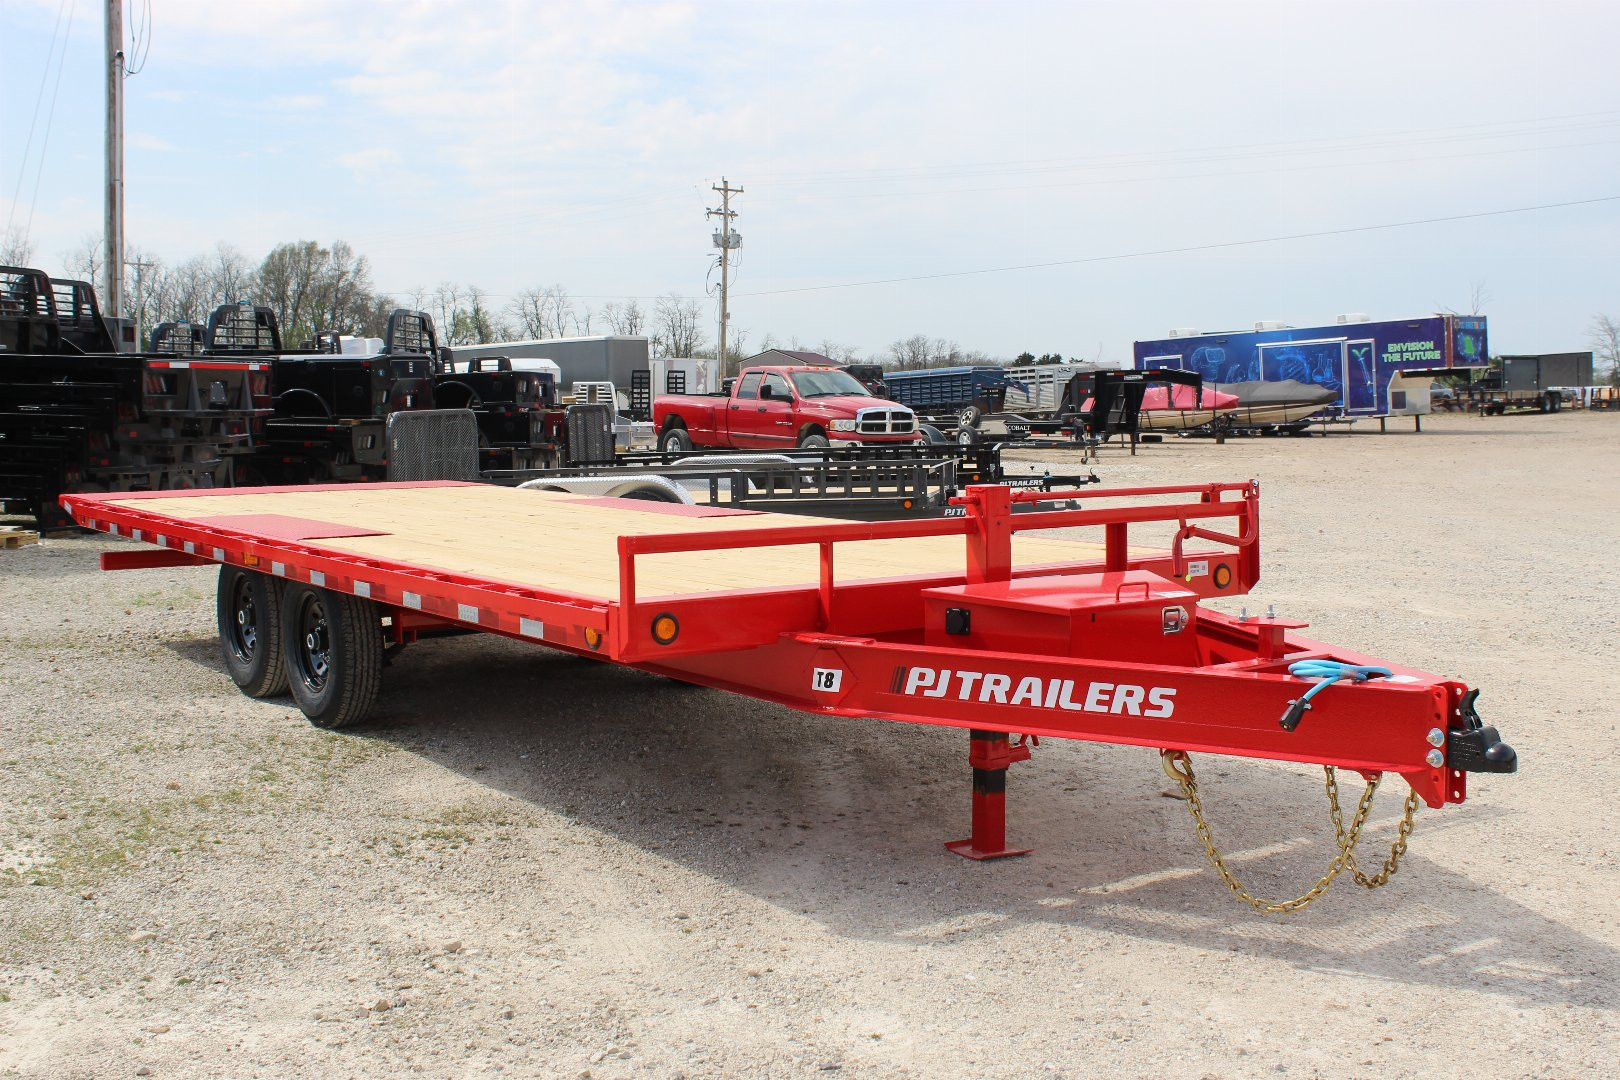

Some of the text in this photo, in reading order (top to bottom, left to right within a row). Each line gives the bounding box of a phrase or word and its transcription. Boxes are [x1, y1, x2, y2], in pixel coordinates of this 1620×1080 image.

[1387, 340, 1434, 352] ENVISION
[1382, 350, 1441, 362] THE FUTURE
[816, 671, 835, 689] T8
[956, 670, 1177, 719] TRAILERS
